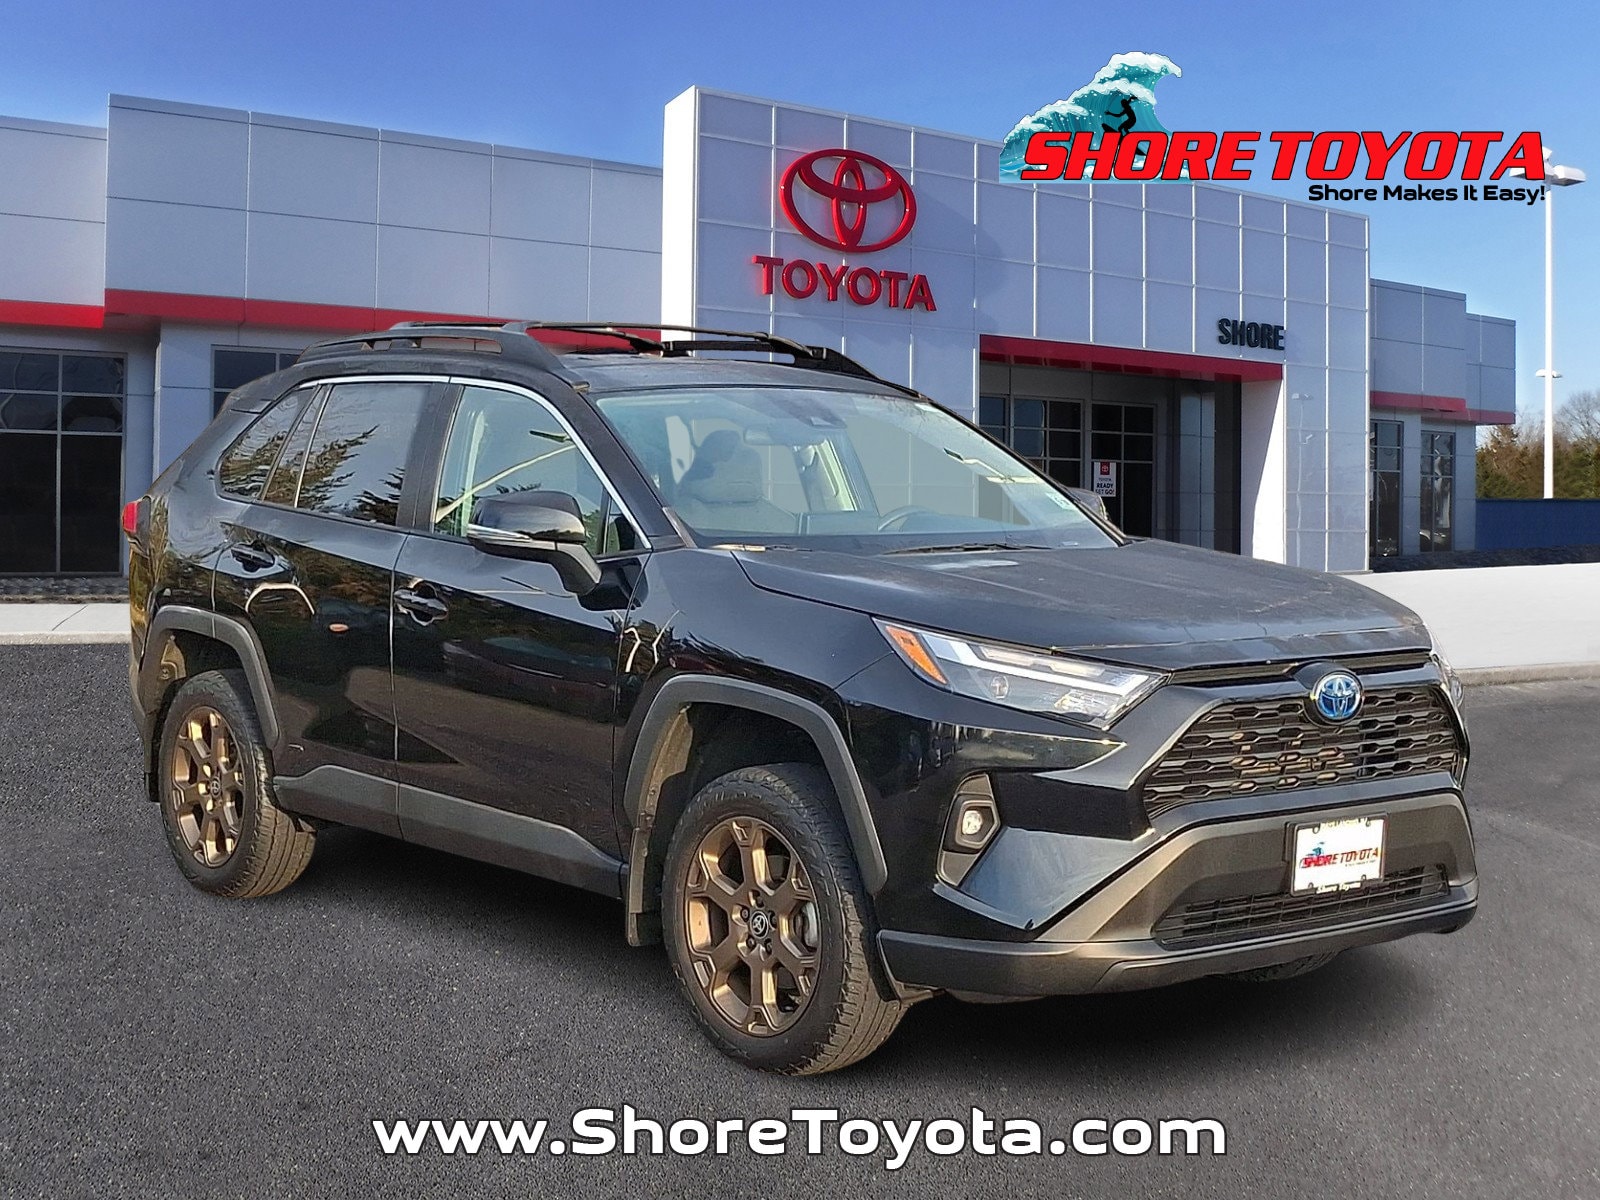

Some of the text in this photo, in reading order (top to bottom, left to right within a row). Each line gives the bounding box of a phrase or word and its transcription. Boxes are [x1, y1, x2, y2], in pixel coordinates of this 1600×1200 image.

[752, 255, 937, 311] TOYOTA
[1218, 318, 1285, 350] SHORE
[1300, 853, 1339, 868] SHORE
[1340, 847, 1379, 863] TOYOTA
